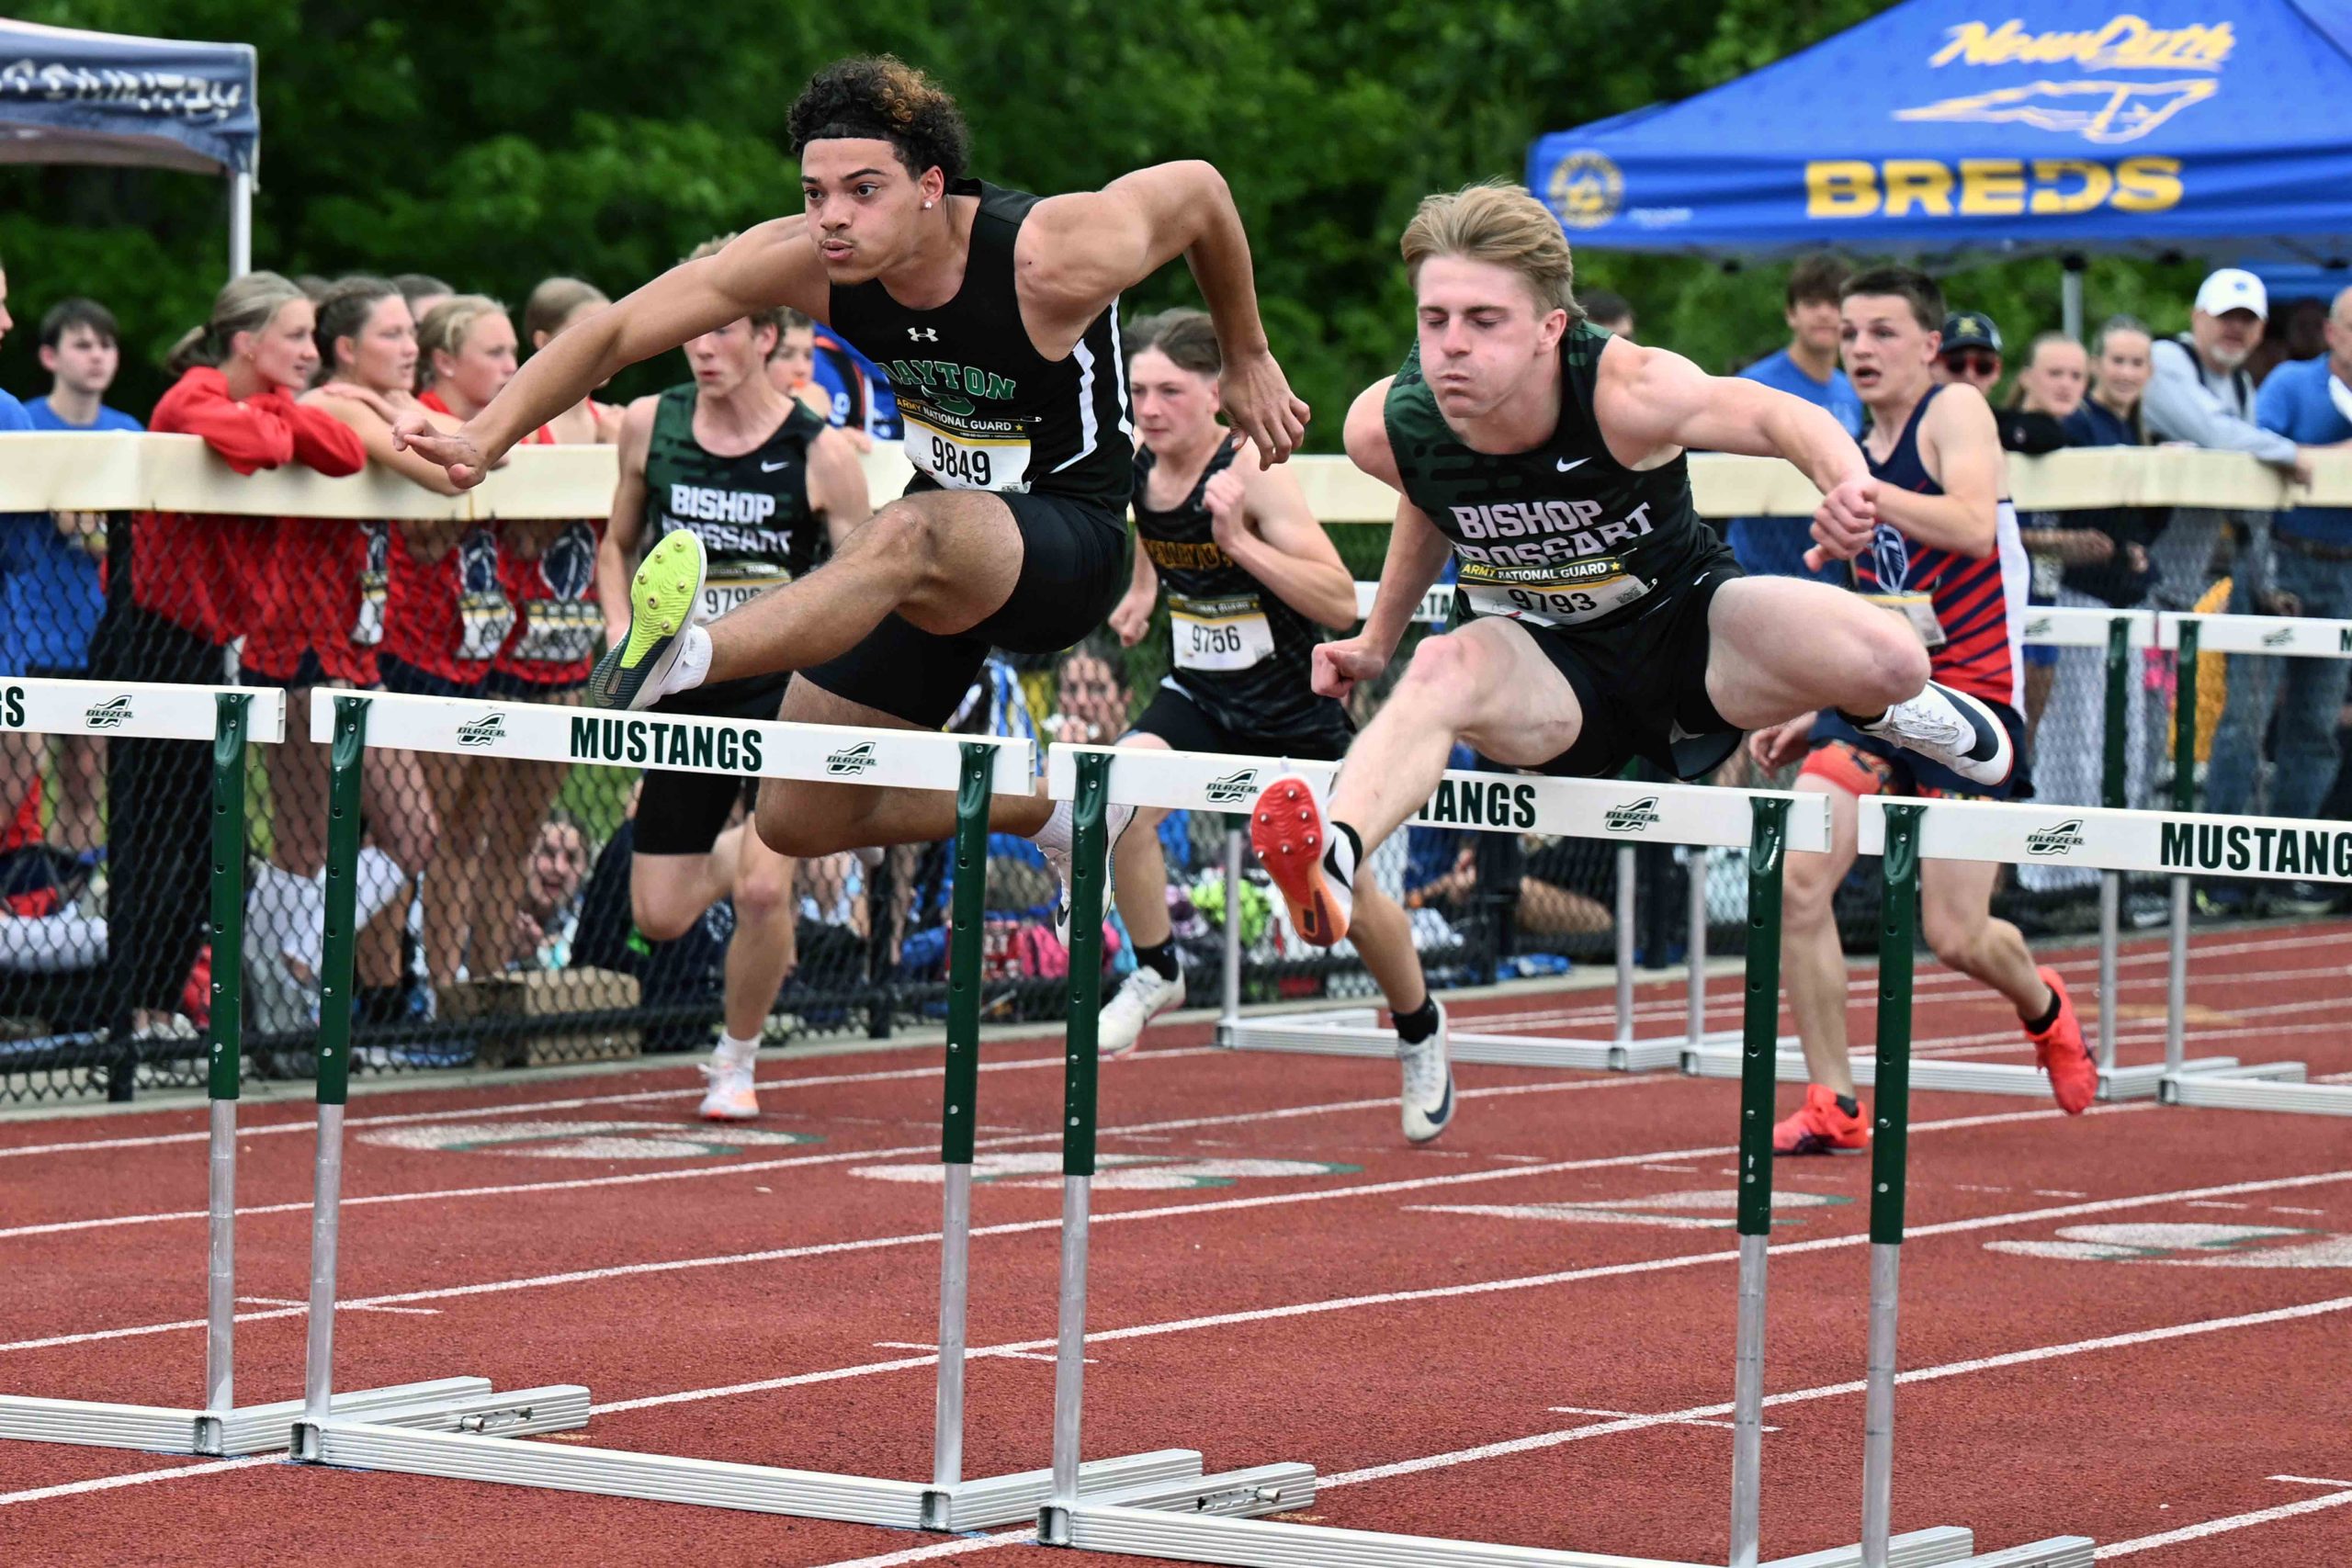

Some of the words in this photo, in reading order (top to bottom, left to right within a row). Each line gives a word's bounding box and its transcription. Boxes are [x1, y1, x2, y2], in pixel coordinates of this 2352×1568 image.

[1804, 155, 2185, 219] BREDS
[922, 405, 968, 429] NATIONAL
[970, 420, 1012, 431] GUARD
[932, 435, 991, 485] 9849
[671, 483, 775, 525] BISHOP
[1449, 500, 1603, 539] BISHOP
[1461, 564, 1496, 578] ARMY
[1498, 569, 1559, 581] NATIONAL
[1560, 562, 1607, 579] GUARD
[1508, 589, 1599, 615] 9793
[1192, 624, 1241, 654] 9756
[85, 708, 134, 719] BLAZER
[457, 726, 506, 738] BLAZER
[570, 716, 763, 773] MUSTANGS
[826, 754, 877, 767] BLAZER
[1205, 782, 1260, 794] BLAZER
[1604, 810, 1661, 822] BLAZER
[2026, 834, 2086, 846] BLAZER
[2160, 821, 2352, 878] MUSTANG
